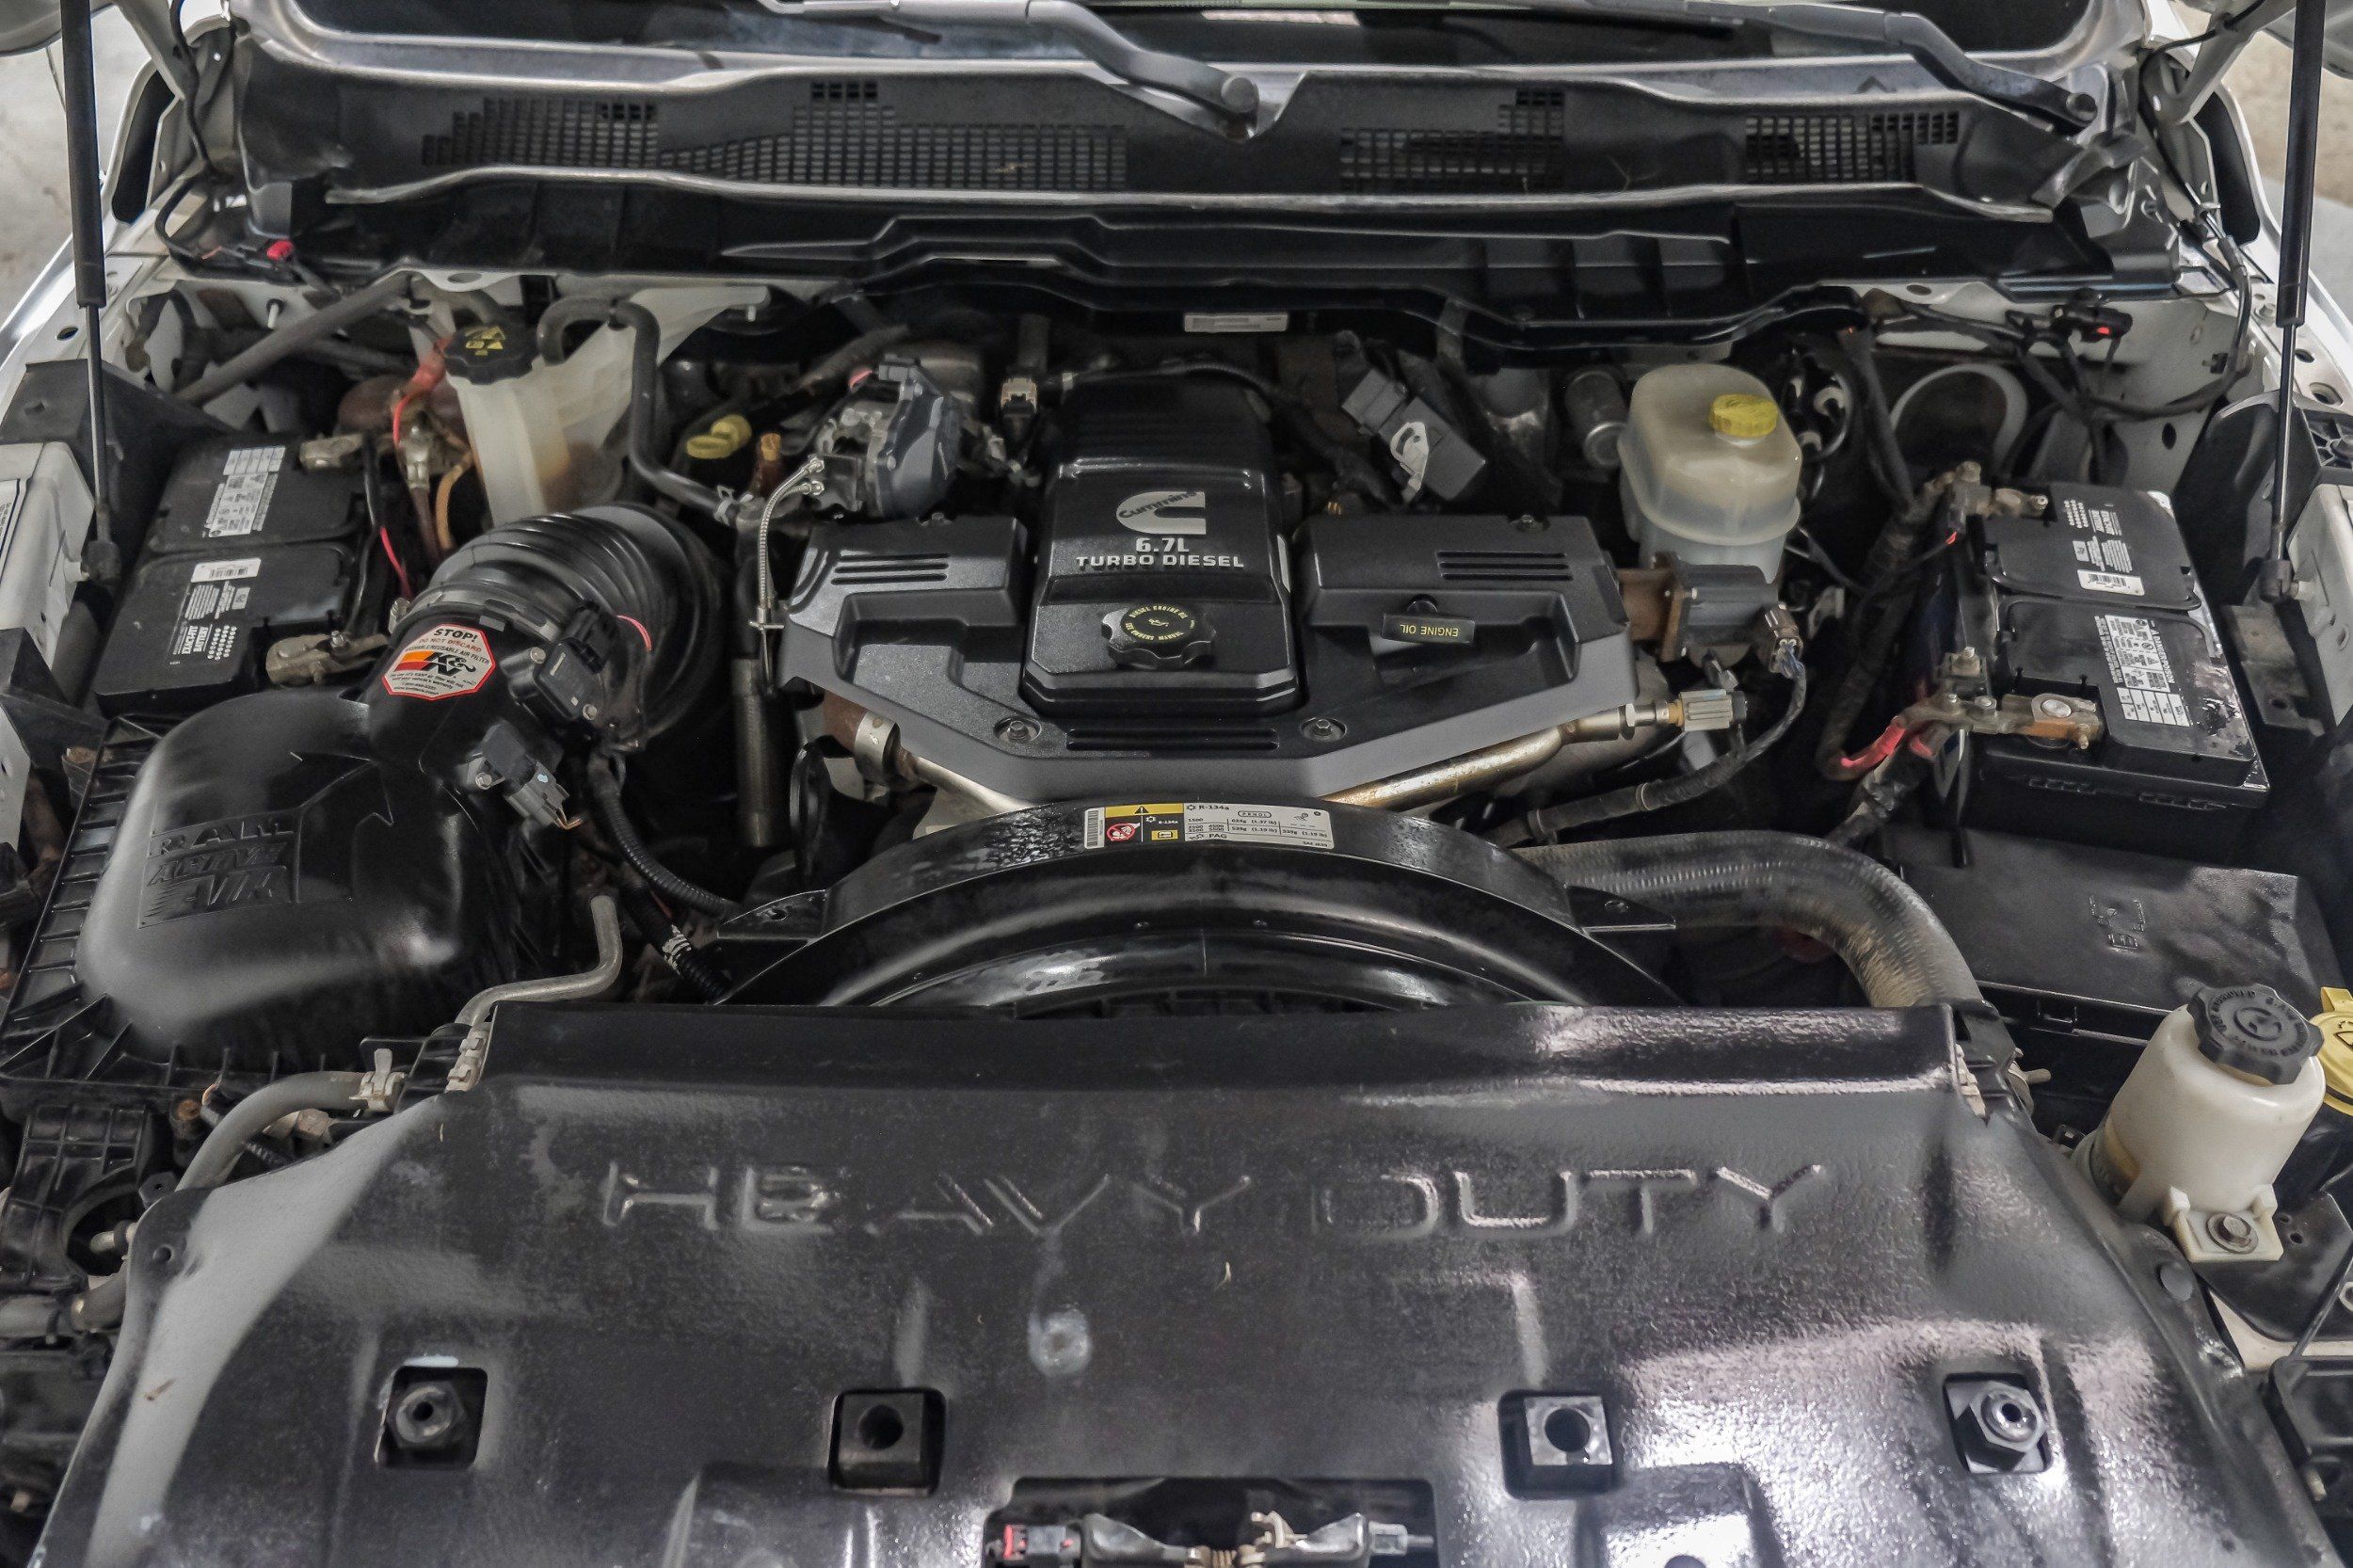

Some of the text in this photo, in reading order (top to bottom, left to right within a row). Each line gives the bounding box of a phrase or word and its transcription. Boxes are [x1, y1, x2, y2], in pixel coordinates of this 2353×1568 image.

[1118, 491, 1197, 519] Cummins
[1135, 537, 1190, 552] 6.7L
[1076, 554, 1244, 568] TURBO DIESEL
[433, 628, 478, 643] STOP!
[1400, 624, 1459, 637] ENGINE OIL
[447, 639, 482, 652] DISCARD
[1311, 1163, 1826, 1238] DUTY
